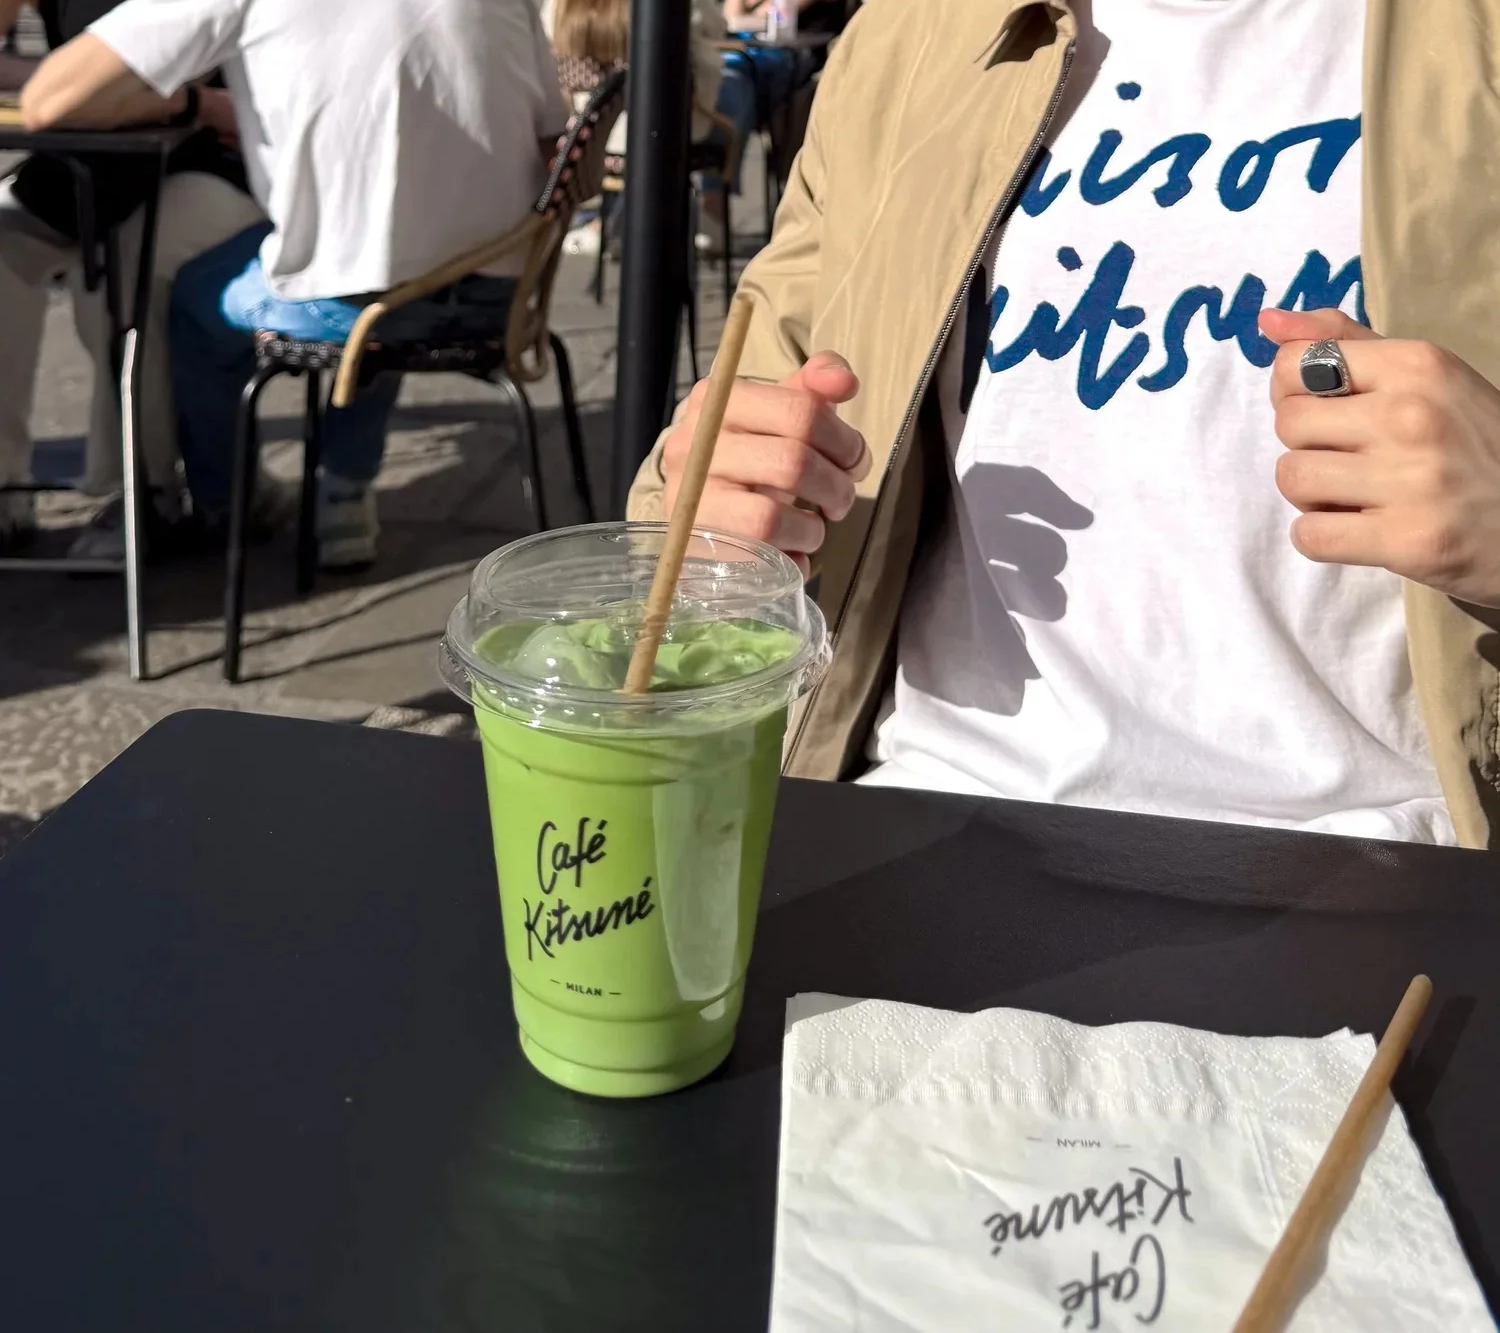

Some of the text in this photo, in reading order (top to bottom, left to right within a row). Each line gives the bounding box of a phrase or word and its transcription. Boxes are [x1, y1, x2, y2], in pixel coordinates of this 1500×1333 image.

[537, 817, 608, 895] Café
[523, 875, 656, 962] Kitsuné
[566, 981, 602, 997] MILAN
[1056, 1137, 1101, 1149] MILAN
[983, 1156, 1194, 1257] Kitsuné
[1058, 1233, 1165, 1331] Café
